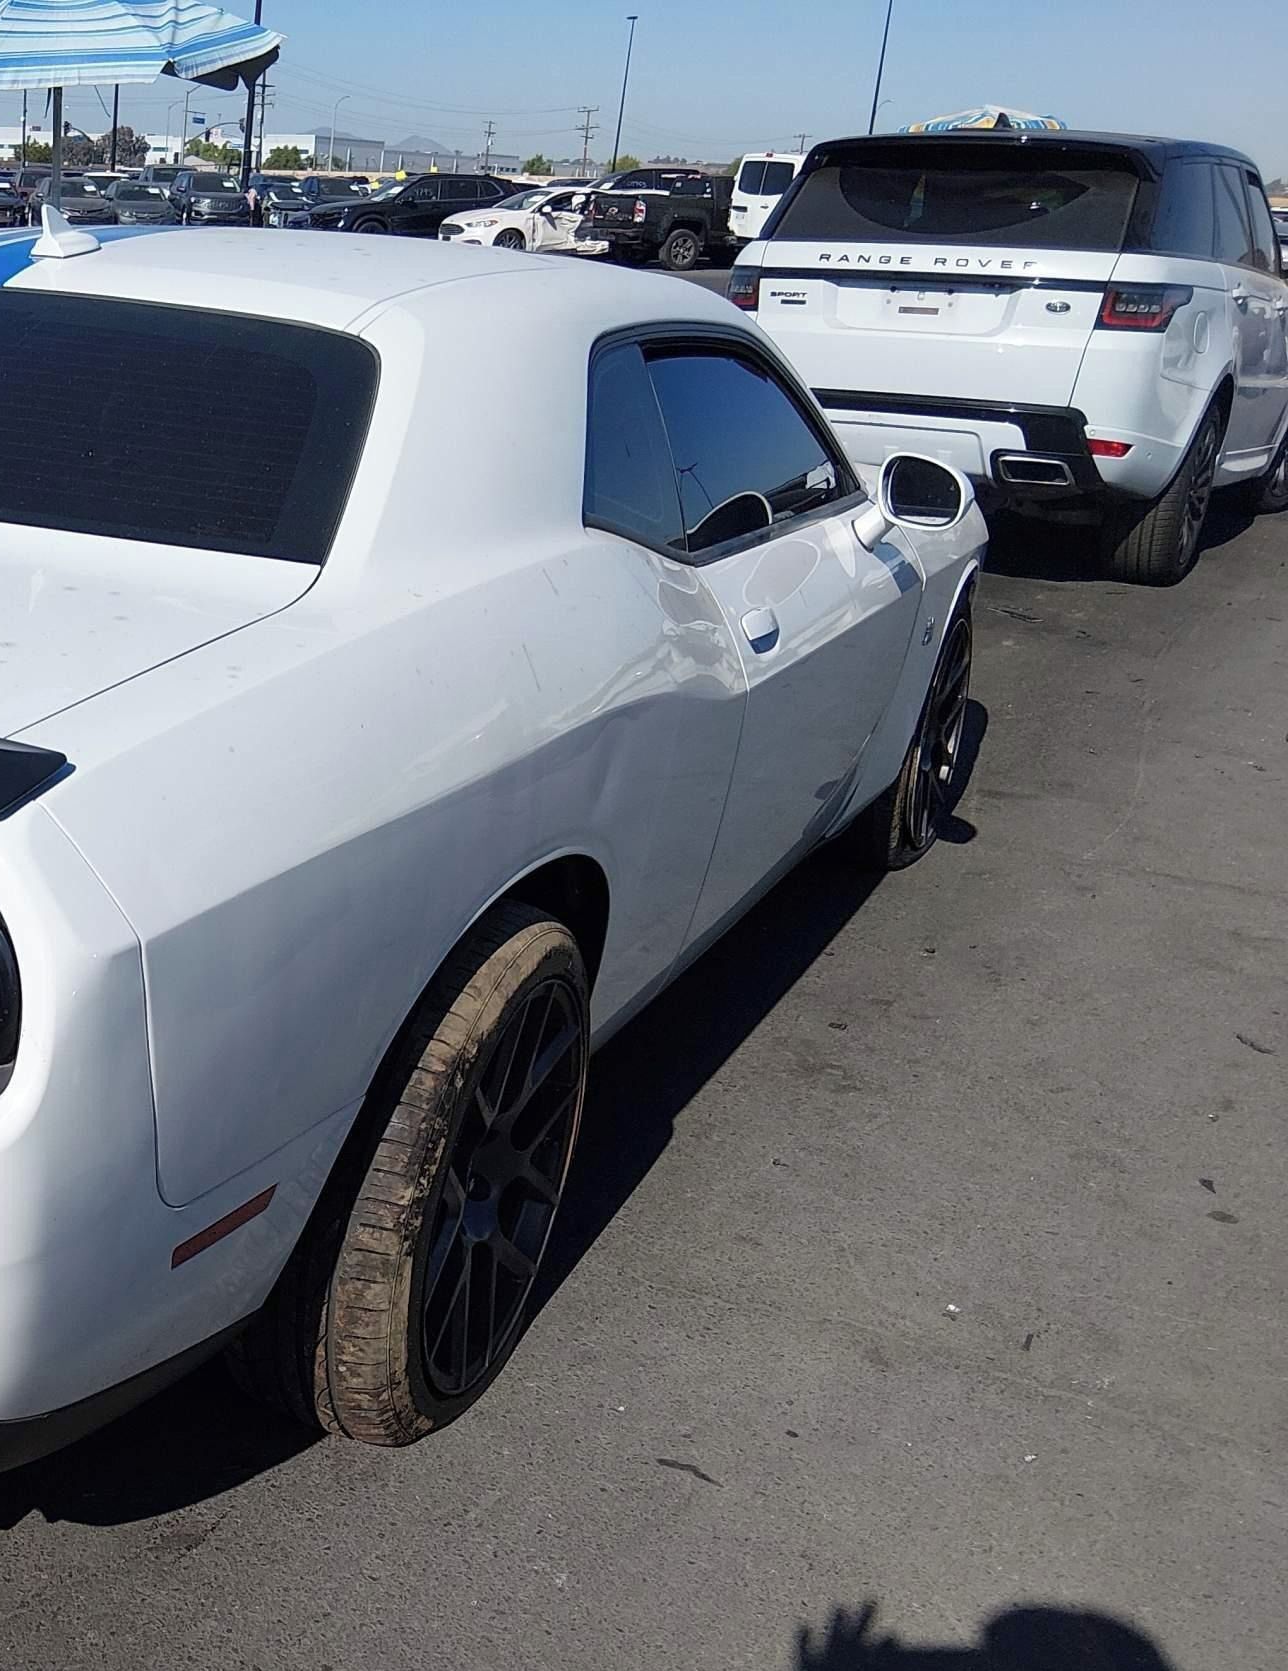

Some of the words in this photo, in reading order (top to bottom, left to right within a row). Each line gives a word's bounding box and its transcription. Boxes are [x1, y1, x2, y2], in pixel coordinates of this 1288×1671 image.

[818, 252, 913, 265] RANGE
[934, 257, 1038, 270] ROVER
[770, 291, 808, 299] SPORT
